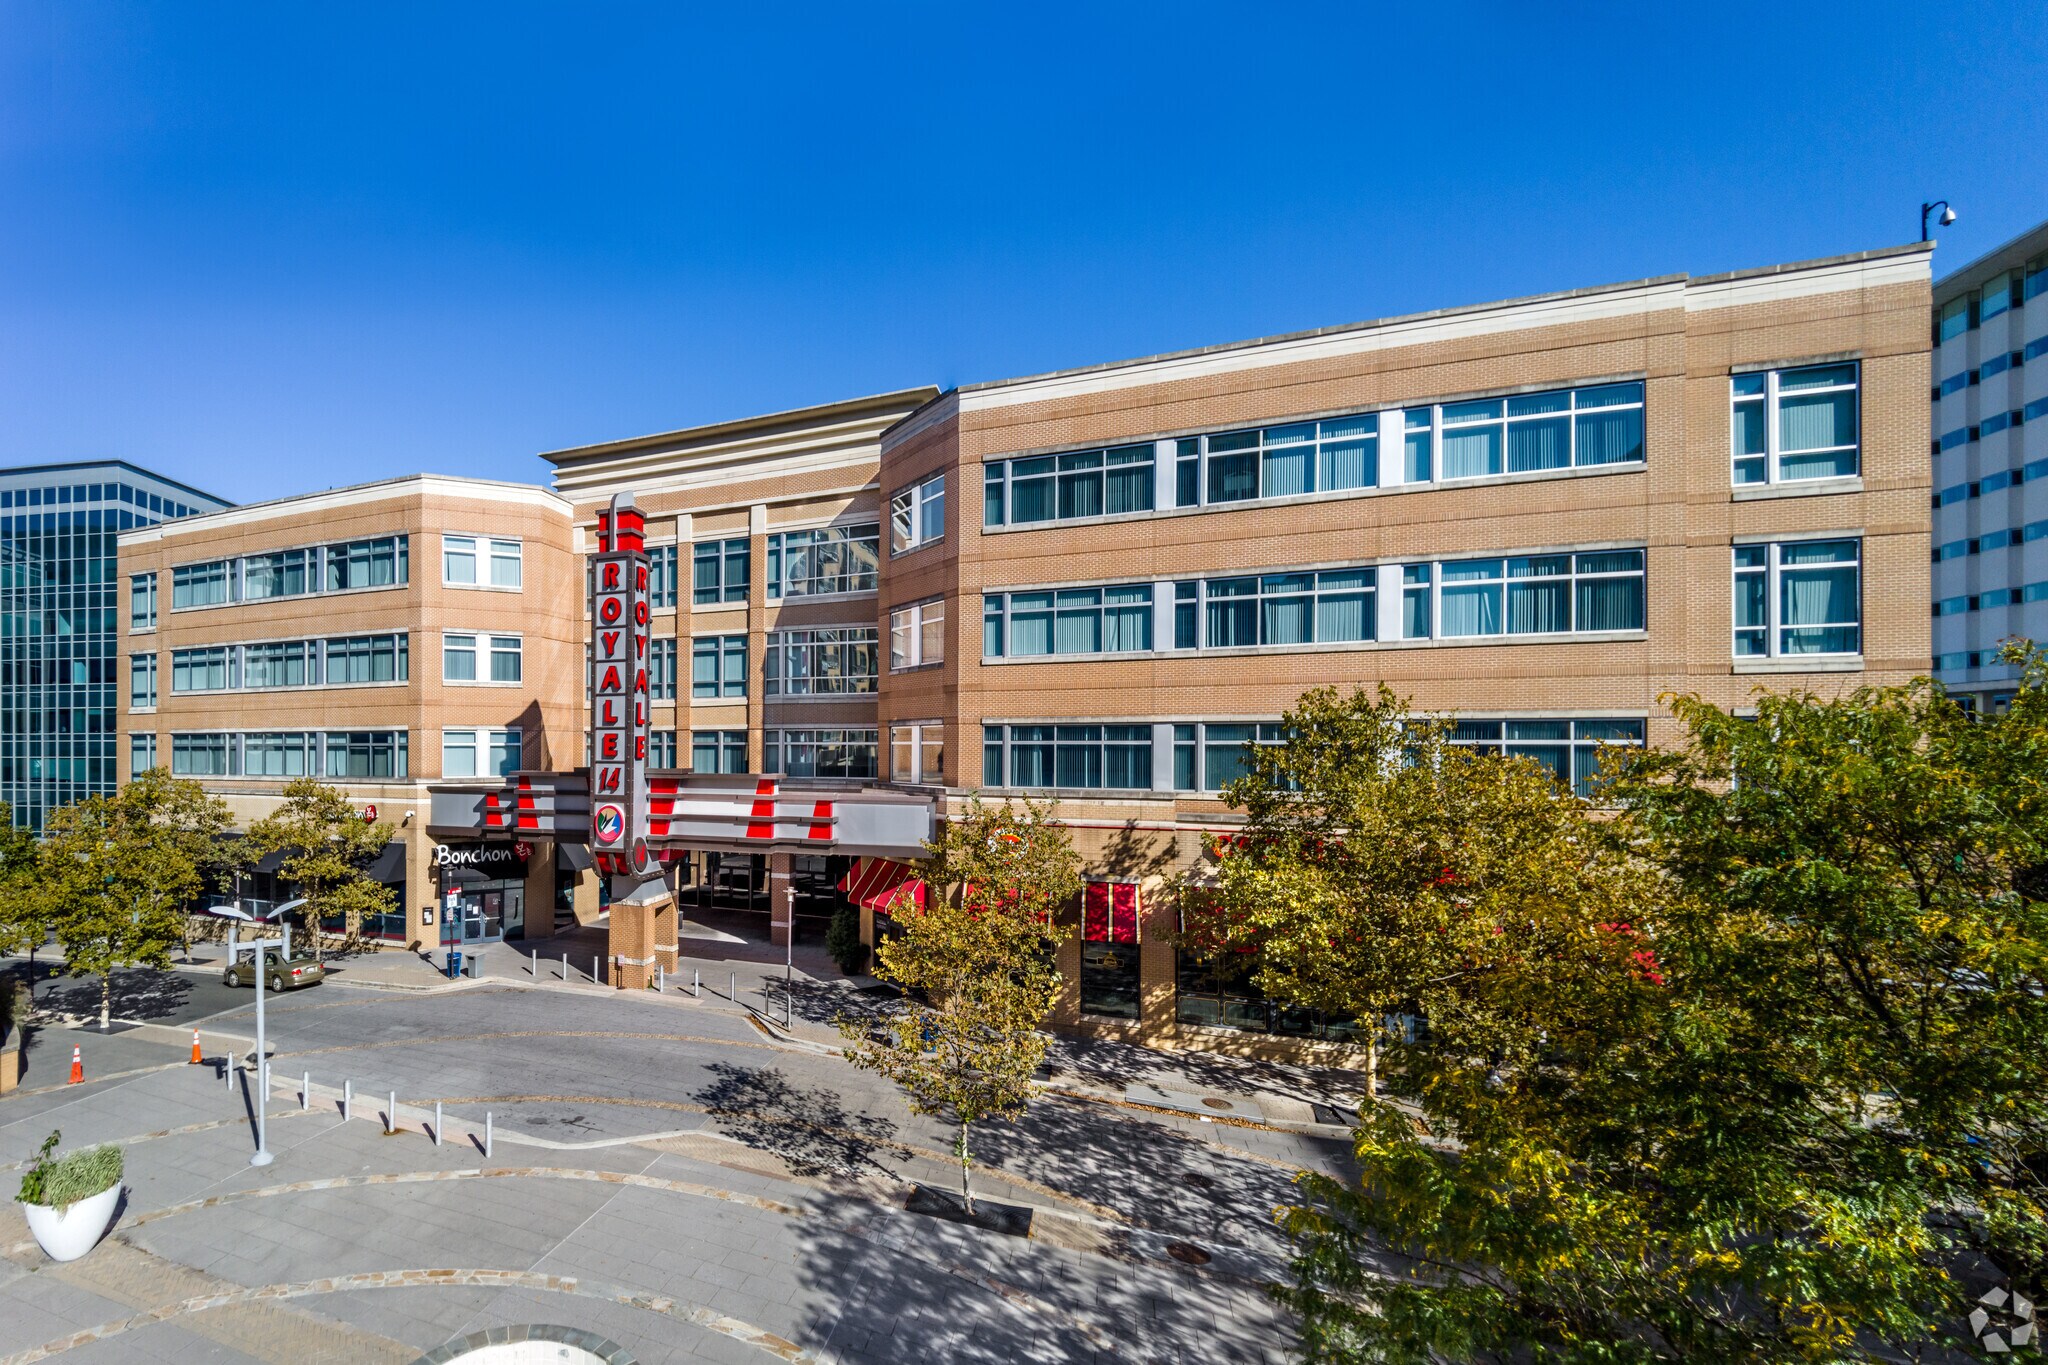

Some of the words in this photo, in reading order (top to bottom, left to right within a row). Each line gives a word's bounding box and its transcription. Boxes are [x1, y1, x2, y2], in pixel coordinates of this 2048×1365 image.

[601, 562, 622, 757] ROYALE
[635, 565, 648, 759] ROYALE
[600, 767, 621, 792] 14
[436, 844, 512, 865] Bonchon
[635, 844, 647, 865] 14
